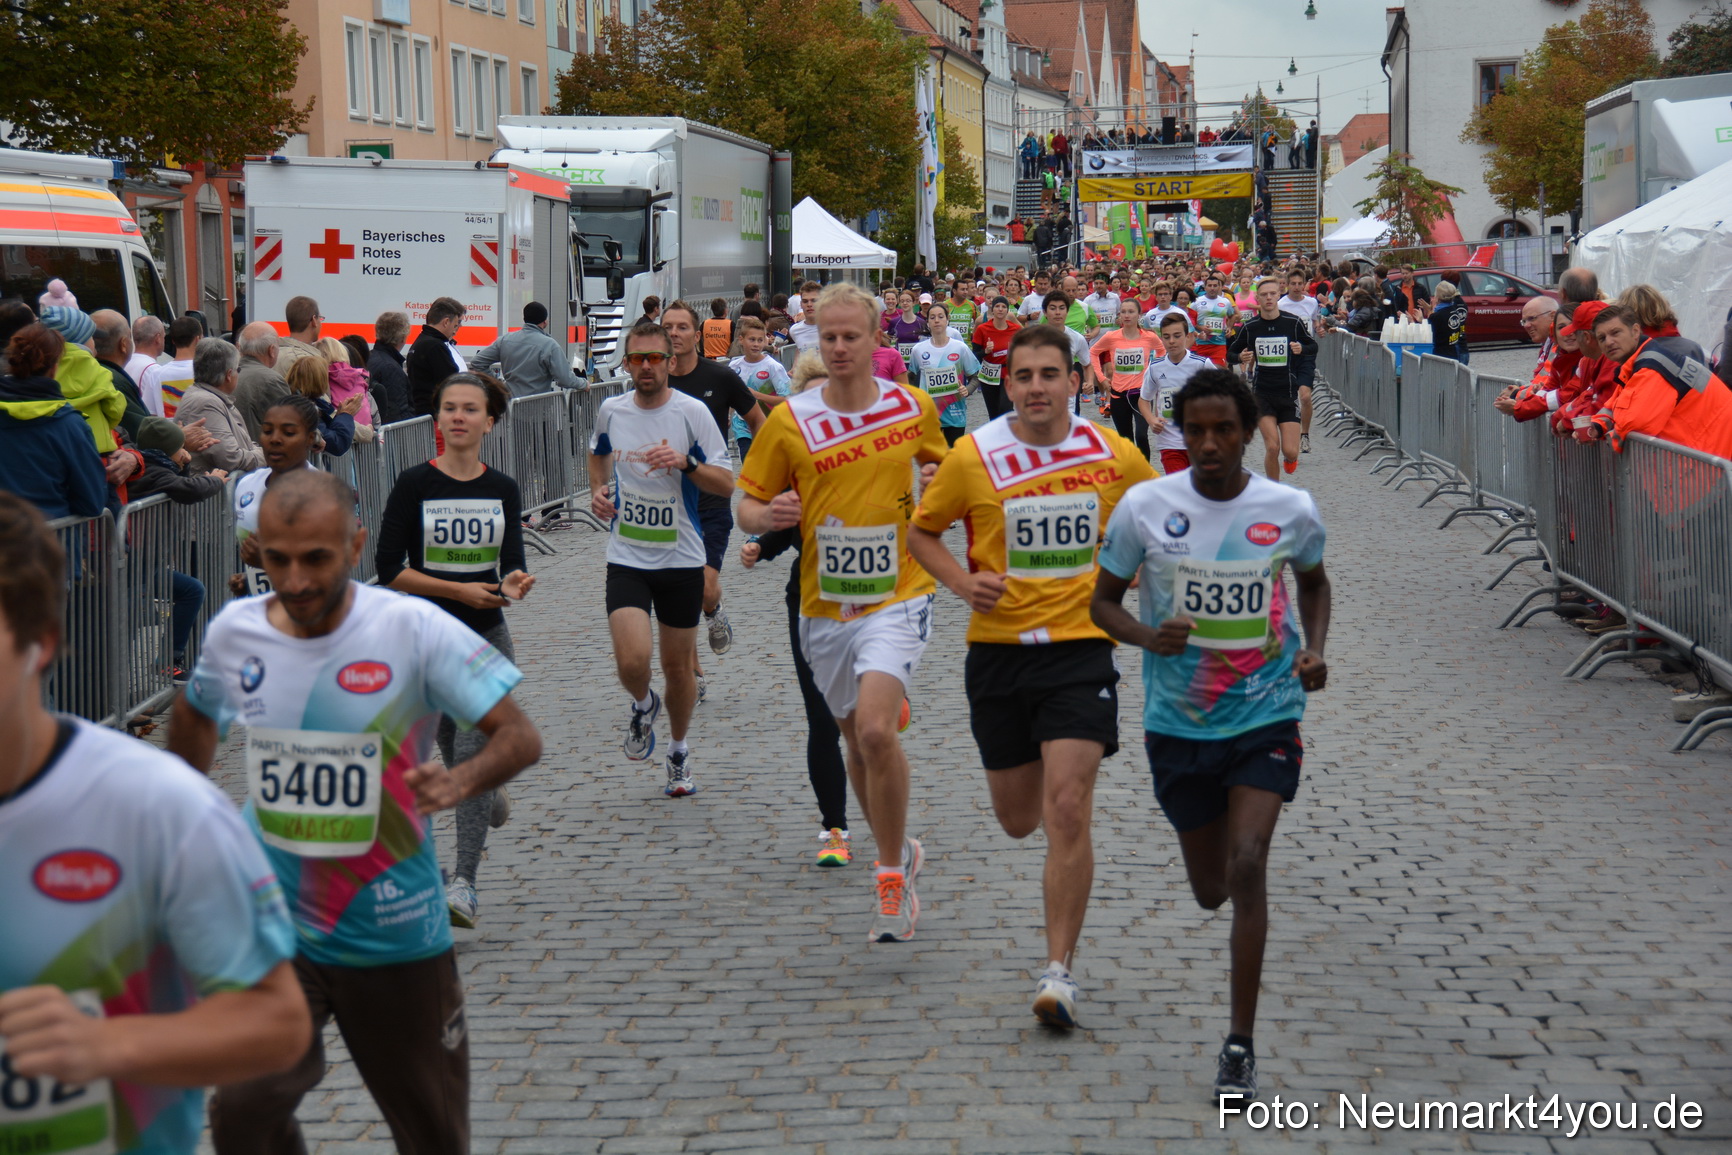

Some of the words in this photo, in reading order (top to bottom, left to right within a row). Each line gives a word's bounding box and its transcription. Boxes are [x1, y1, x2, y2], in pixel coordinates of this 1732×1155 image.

[1134, 181, 1194, 196] START
[741, 190, 763, 238] BOCK
[362, 229, 445, 243] Bayerisches
[362, 247, 401, 259] Rotes
[797, 254, 851, 265] Laufsport
[362, 264, 401, 276] Kreuz
[462, 314, 483, 322] ayern
[1258, 344, 1285, 355] 5148
[1117, 354, 1142, 365] 5092
[981, 366, 999, 377] 5067
[929, 373, 956, 387] 5026
[1164, 396, 1172, 409] 5
[814, 444, 868, 475] MAX
[873, 424, 923, 452] BÖGL
[1061, 467, 1124, 493] BÖGL
[638, 496, 669, 504] Neumarkt
[426, 507, 453, 515] PARTL
[624, 501, 673, 527] 5300
[1007, 504, 1038, 515] PARTL
[1040, 503, 1083, 513] Neumarkt
[434, 518, 495, 545] 5091
[1016, 515, 1091, 547] 5166
[818, 533, 843, 543] PARTL
[844, 534, 885, 543] Neumarkt
[1163, 541, 1190, 551] PARTL
[447, 551, 482, 563] Sandra
[825, 545, 891, 574] 5203
[1029, 554, 1077, 567] Michael
[1178, 565, 1209, 578] PARTL
[1212, 569, 1259, 579] Neumarkt
[841, 581, 875, 593] Stefan
[1184, 580, 1264, 615] 5330
[251, 738, 288, 753] PARTL
[291, 743, 355, 757] Neumarkt
[260, 759, 367, 808] 5400
[370, 879, 405, 902] 16.
